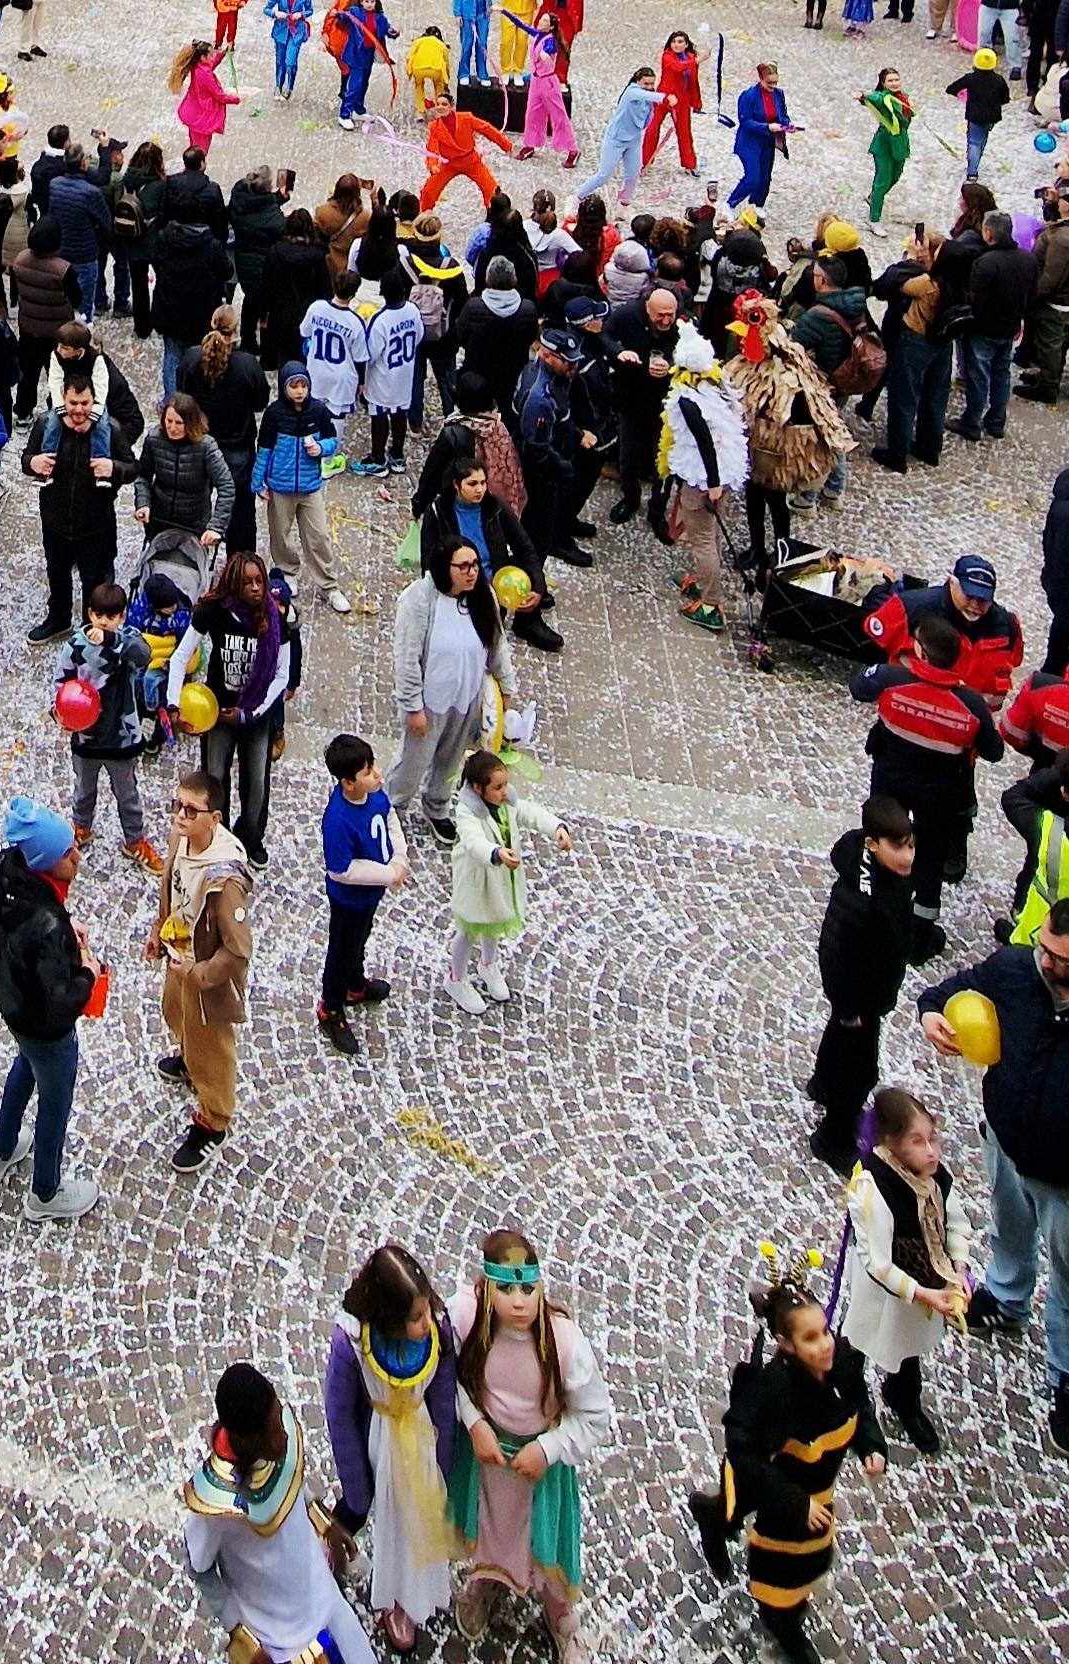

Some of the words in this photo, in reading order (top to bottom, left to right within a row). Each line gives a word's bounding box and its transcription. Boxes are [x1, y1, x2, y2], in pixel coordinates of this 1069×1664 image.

[312, 316, 352, 338] NCOLETTI
[314, 328, 346, 364] 10
[387, 331, 416, 369] 20
[224, 633, 244, 650] TAKE
[891, 701, 970, 732] CARABERI
